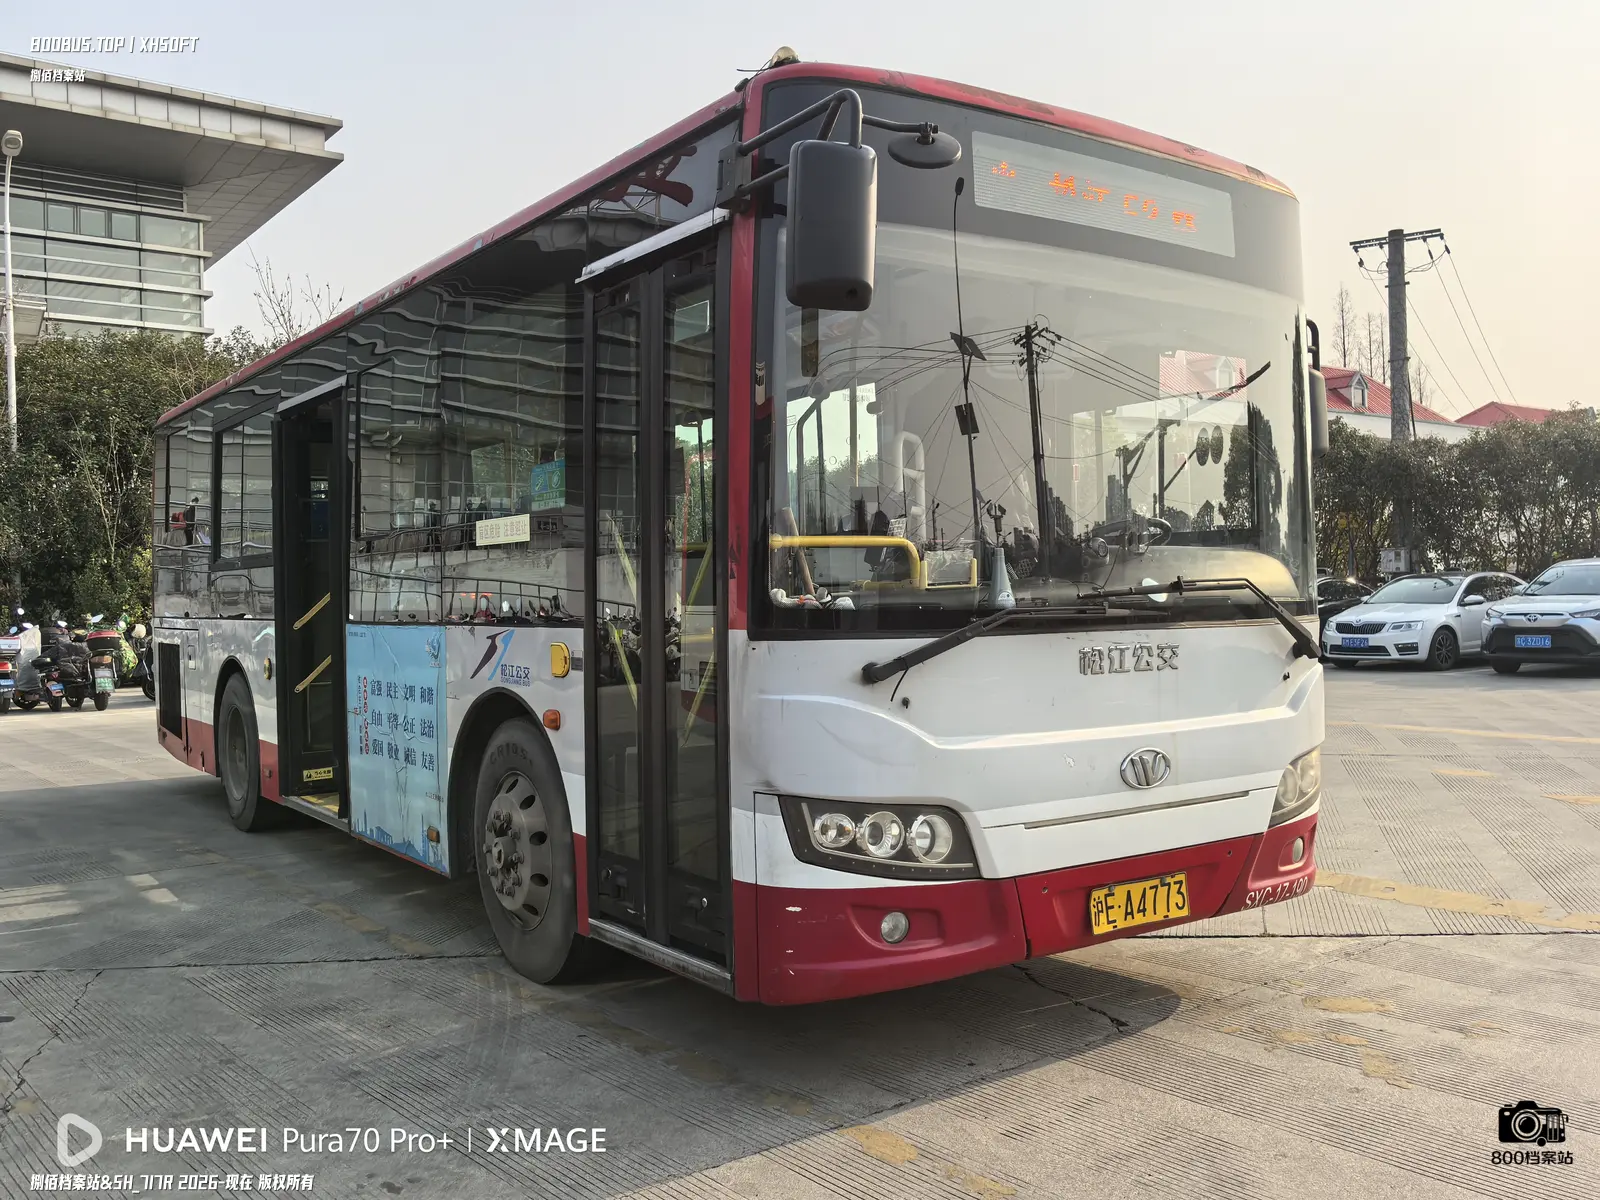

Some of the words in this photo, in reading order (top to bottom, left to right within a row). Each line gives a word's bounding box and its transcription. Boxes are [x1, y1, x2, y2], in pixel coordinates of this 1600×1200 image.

[500, 663, 531, 680] 松江公交
[1079, 642, 1180, 676] 松江公交
[370, 679, 383, 697] 富强
[386, 681, 399, 700] 民主
[403, 684, 416, 702] 文明
[420, 686, 434, 705] 和谐
[371, 709, 383, 728] 自由
[387, 712, 399, 731] 平等
[403, 714, 416, 734] 公正
[420, 718, 434, 739] 法治
[371, 738, 384, 757] 爱国
[387, 741, 400, 761] 敬业
[403, 746, 417, 767] 诚信
[421, 750, 435, 772] 友善
